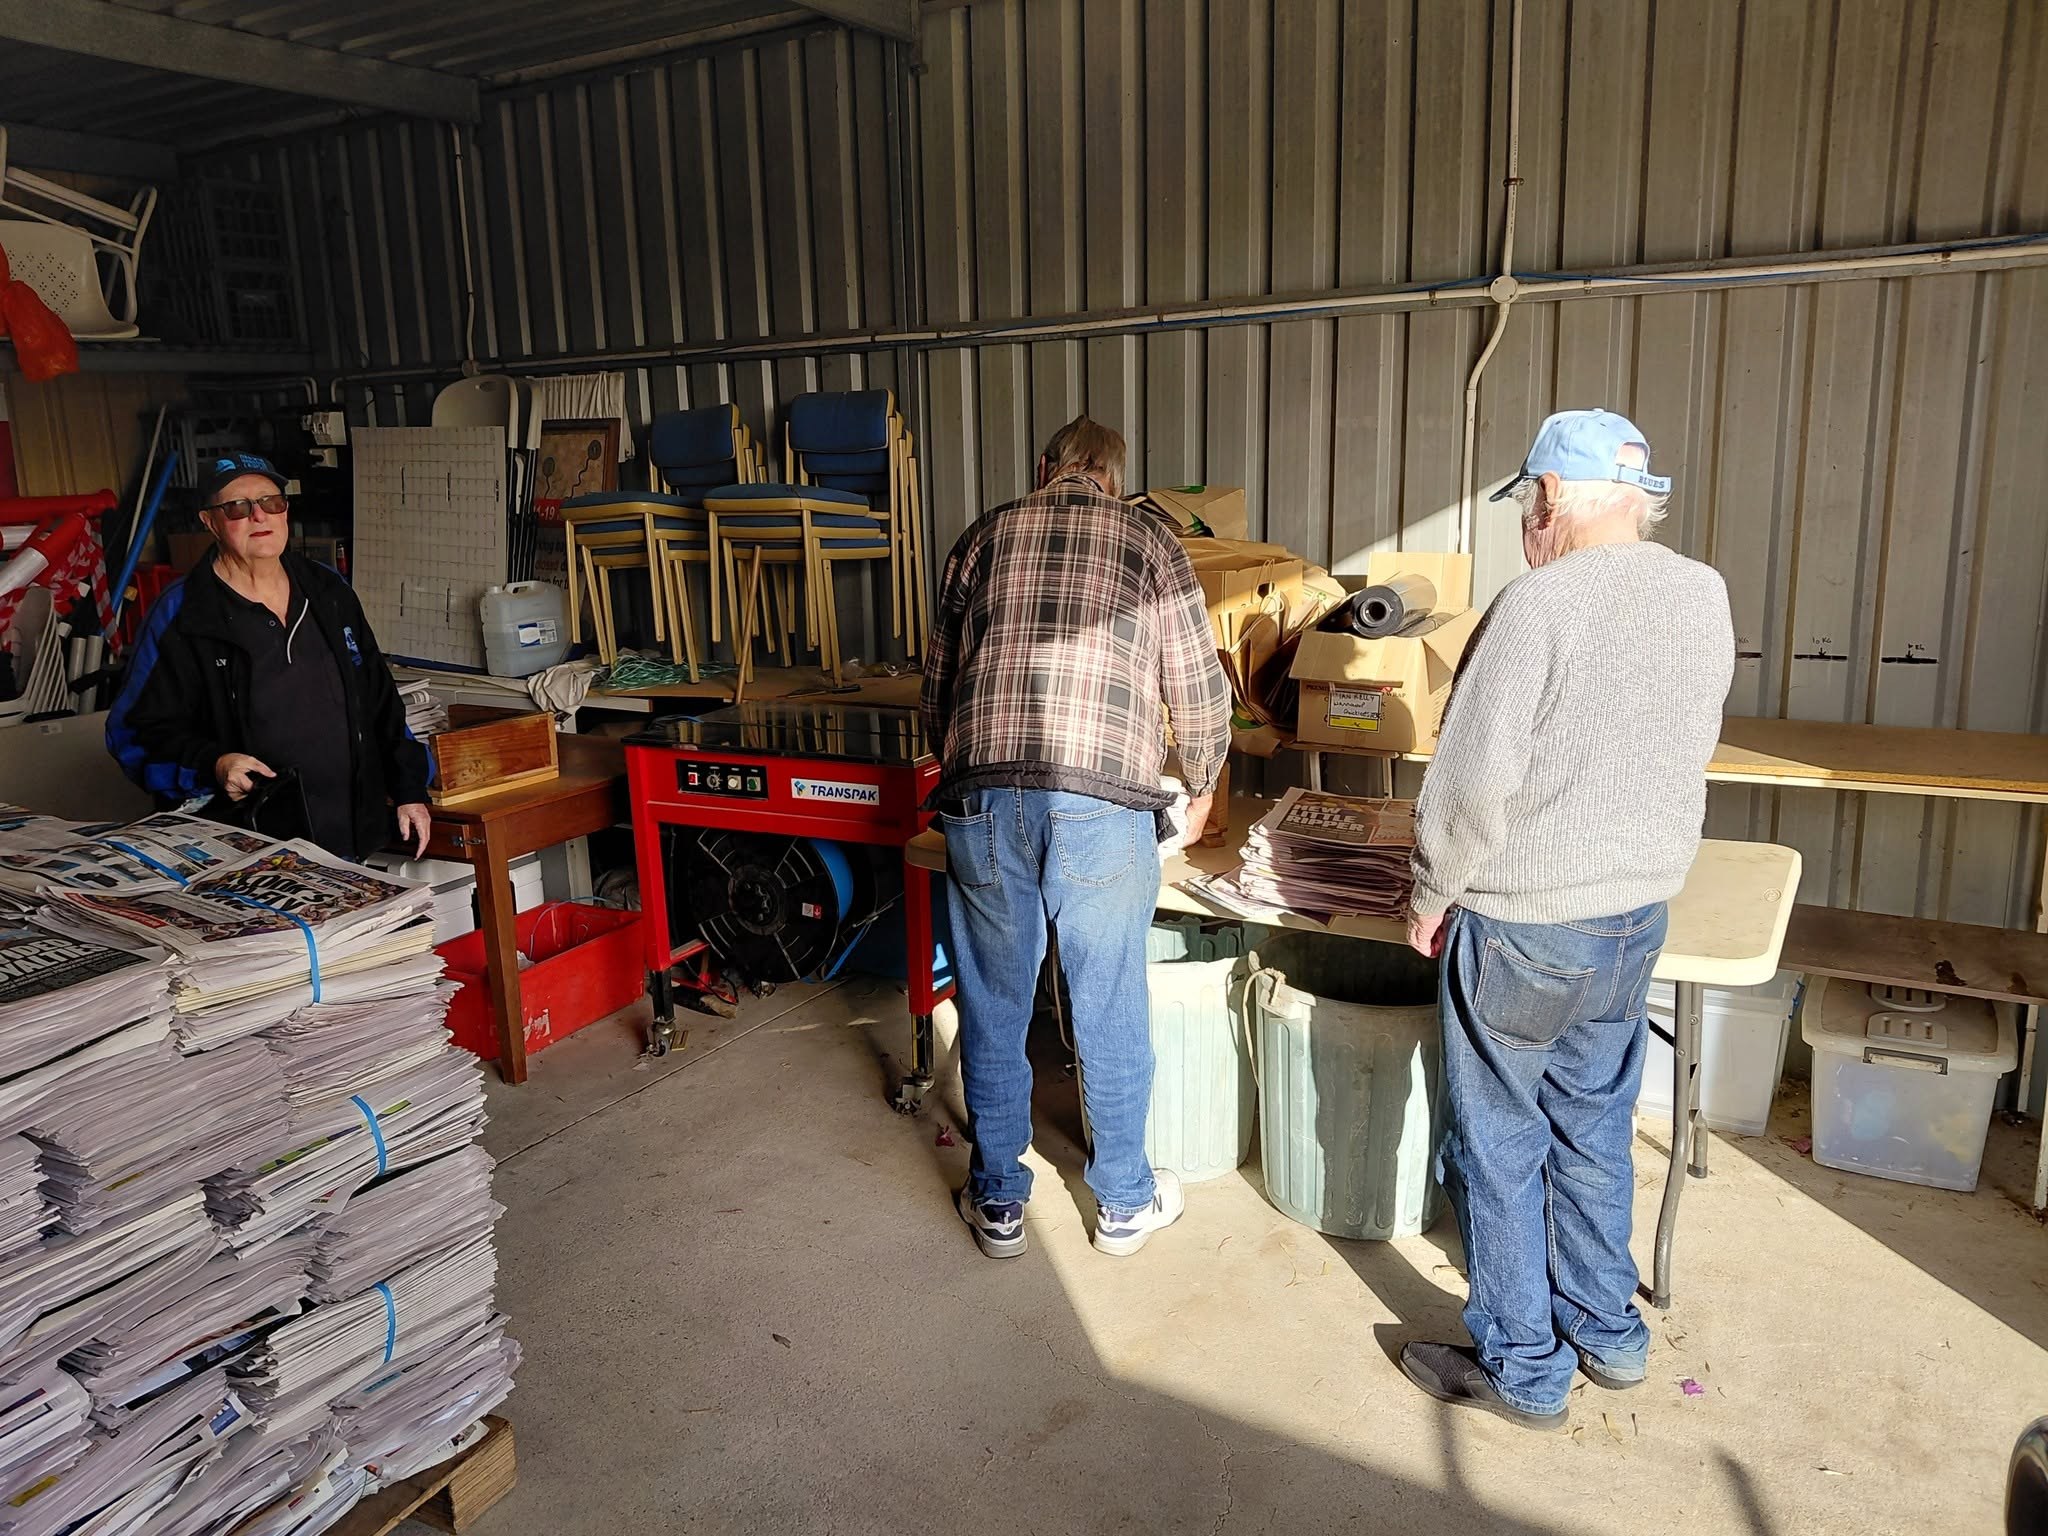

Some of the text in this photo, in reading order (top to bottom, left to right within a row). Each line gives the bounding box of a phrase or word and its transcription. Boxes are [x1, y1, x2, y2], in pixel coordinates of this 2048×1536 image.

[1639, 476, 1665, 488] BLUES
[810, 784, 877, 801] TRANSPAK
[1292, 803, 1341, 814] NEW
[1285, 814, 1365, 832] RIPPER
[1289, 809, 1359, 823] LITTLE
